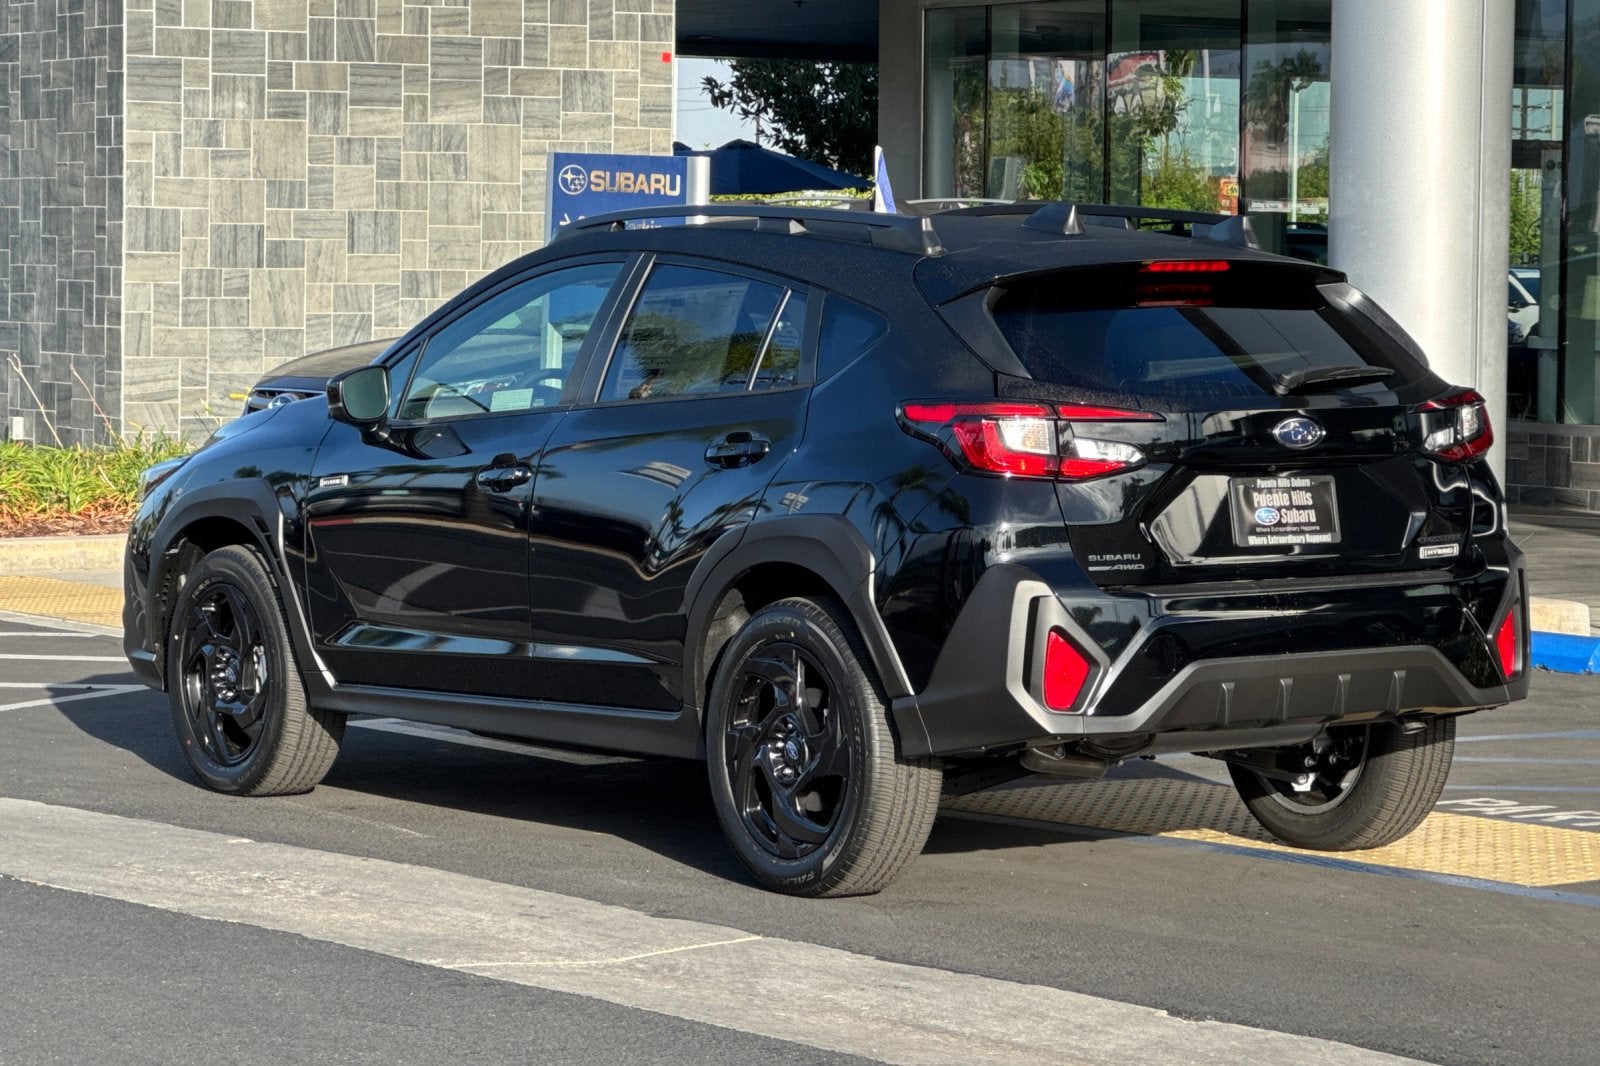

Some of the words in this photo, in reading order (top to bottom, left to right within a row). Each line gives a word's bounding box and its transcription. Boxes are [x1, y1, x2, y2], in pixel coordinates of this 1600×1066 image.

[590, 170, 681, 196] SUBARU
[1252, 491, 1290, 507] Puente
[1290, 489, 1313, 506] Hills
[1280, 507, 1317, 523] Subaru
[1088, 553, 1141, 561] SUBARU
[1111, 563, 1146, 571] AWD
